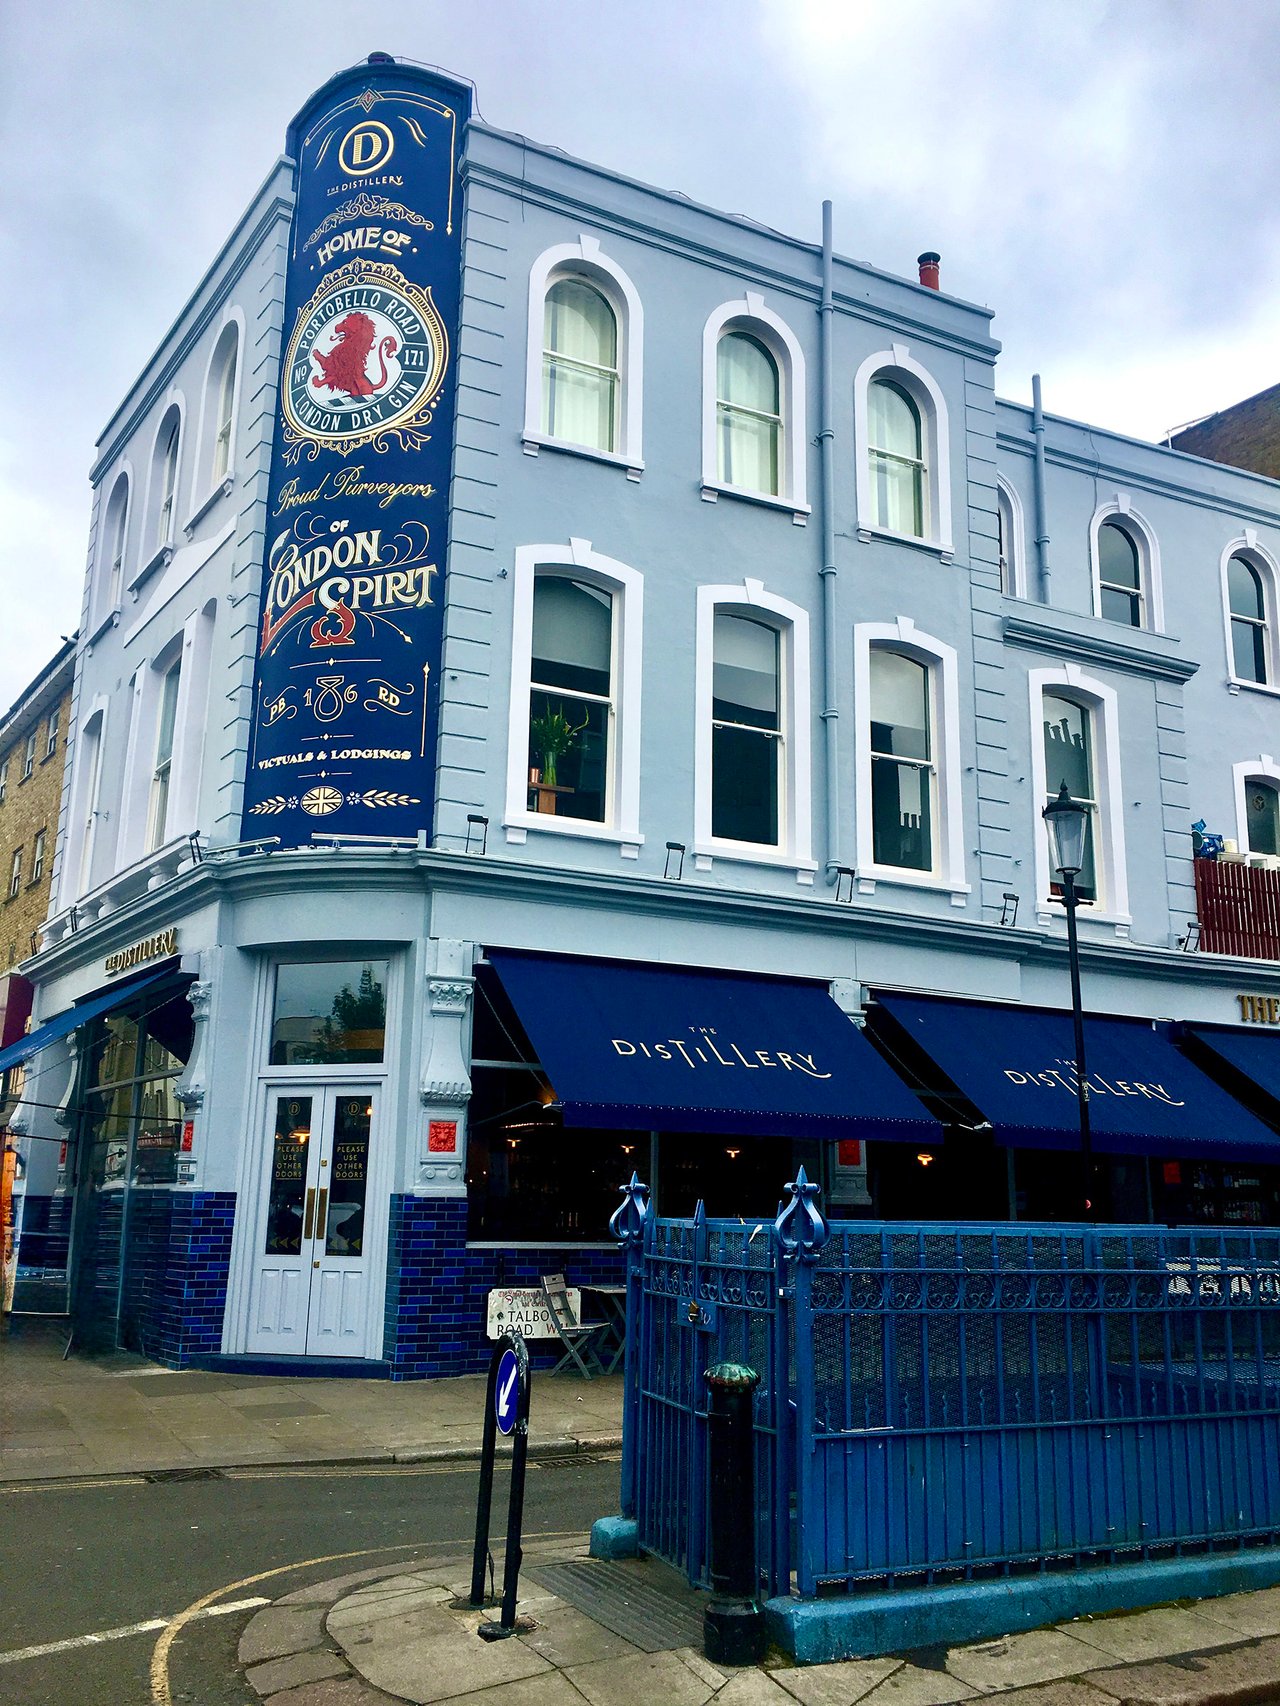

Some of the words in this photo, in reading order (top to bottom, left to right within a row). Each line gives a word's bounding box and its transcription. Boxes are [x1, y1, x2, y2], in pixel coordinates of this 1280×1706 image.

[352, 132, 382, 165] D
[326, 186, 339, 196] THE
[341, 175, 404, 192] DISTILLERY
[317, 227, 382, 267] HOME
[383, 230, 412, 248] OF
[300, 291, 381, 350] PORTOBELLO
[384, 299, 420, 335] ROAD
[404, 350, 424, 367] 171
[295, 393, 341, 431] LONDON
[352, 404, 383, 429] DRY
[388, 380, 418, 409] GIN
[272, 473, 331, 517] Proud
[324, 466, 437, 509] Purveyors
[329, 519, 350, 533] OF
[260, 528, 383, 640] LONDON
[312, 564, 438, 630] SPIRIT
[269, 697, 286, 721] PB
[303, 675, 358, 722] 186
[378, 686, 400, 707] RD
[258, 751, 313, 770] VICTUALS
[316, 751, 328, 761] &
[331, 749, 412, 761] LODGINGS
[117, 927, 179, 972] DISTILLERY
[689, 1026, 718, 1035] THE
[611, 1036, 832, 1079] DISTILLERY
[1054, 1058, 1078, 1066] THE
[276, 1162, 302, 1170] OTHER
[508, 1310, 550, 1323] TALBO
